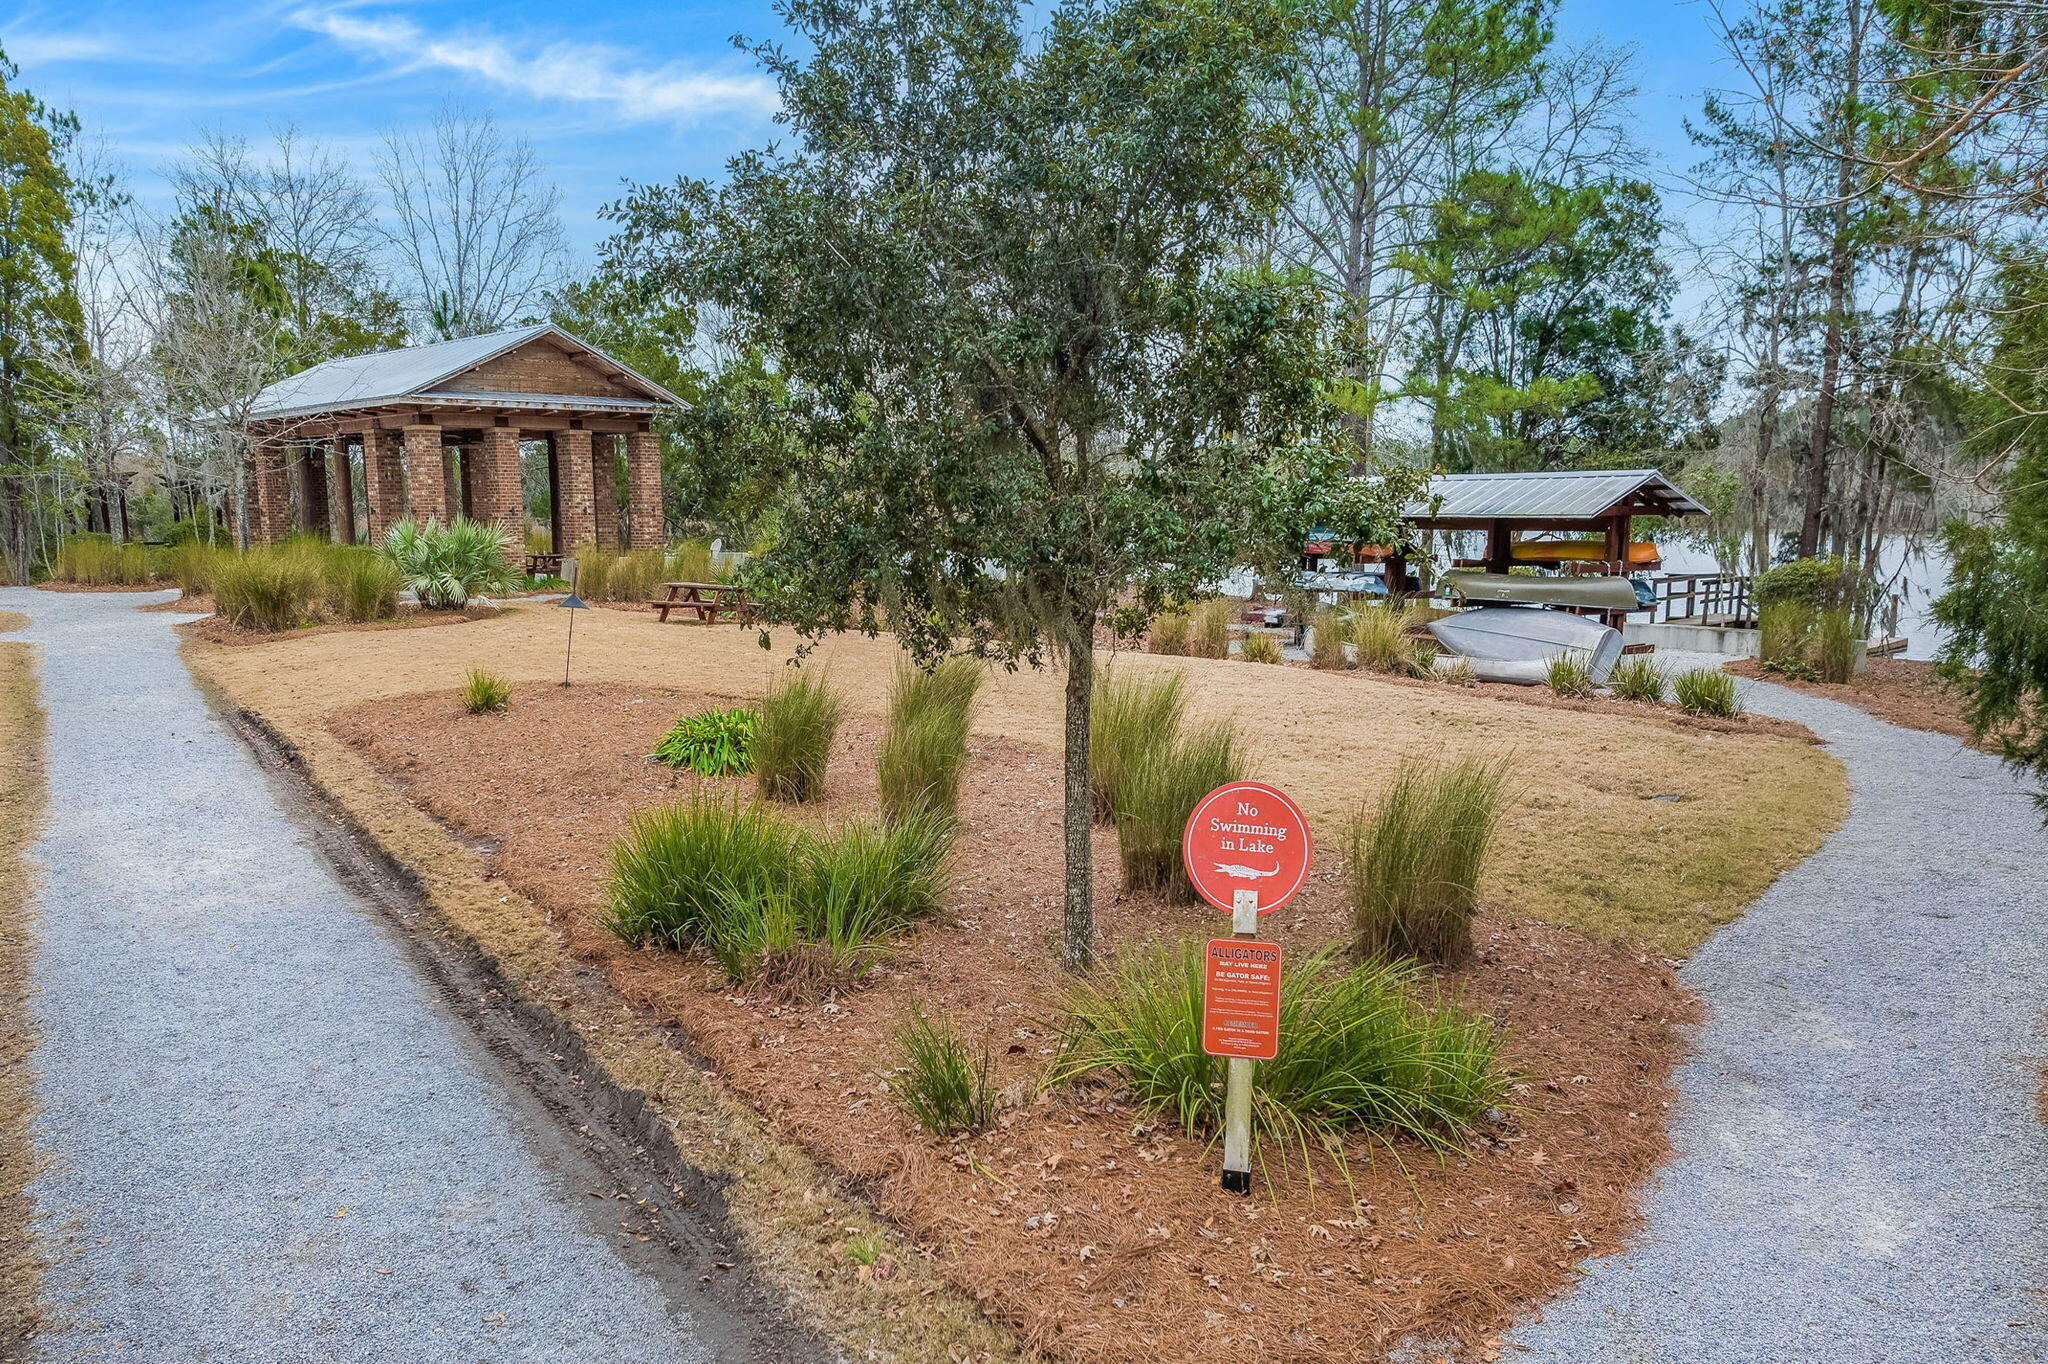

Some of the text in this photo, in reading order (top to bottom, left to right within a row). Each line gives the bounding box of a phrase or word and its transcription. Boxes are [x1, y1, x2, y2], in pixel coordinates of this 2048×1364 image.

[1237, 801, 1259, 817] No
[1210, 818, 1287, 840] Swimming
[1220, 836, 1274, 854] in Lake
[1211, 947, 1277, 962] ALLIGATORS
[1215, 970, 1226, 978] BE
